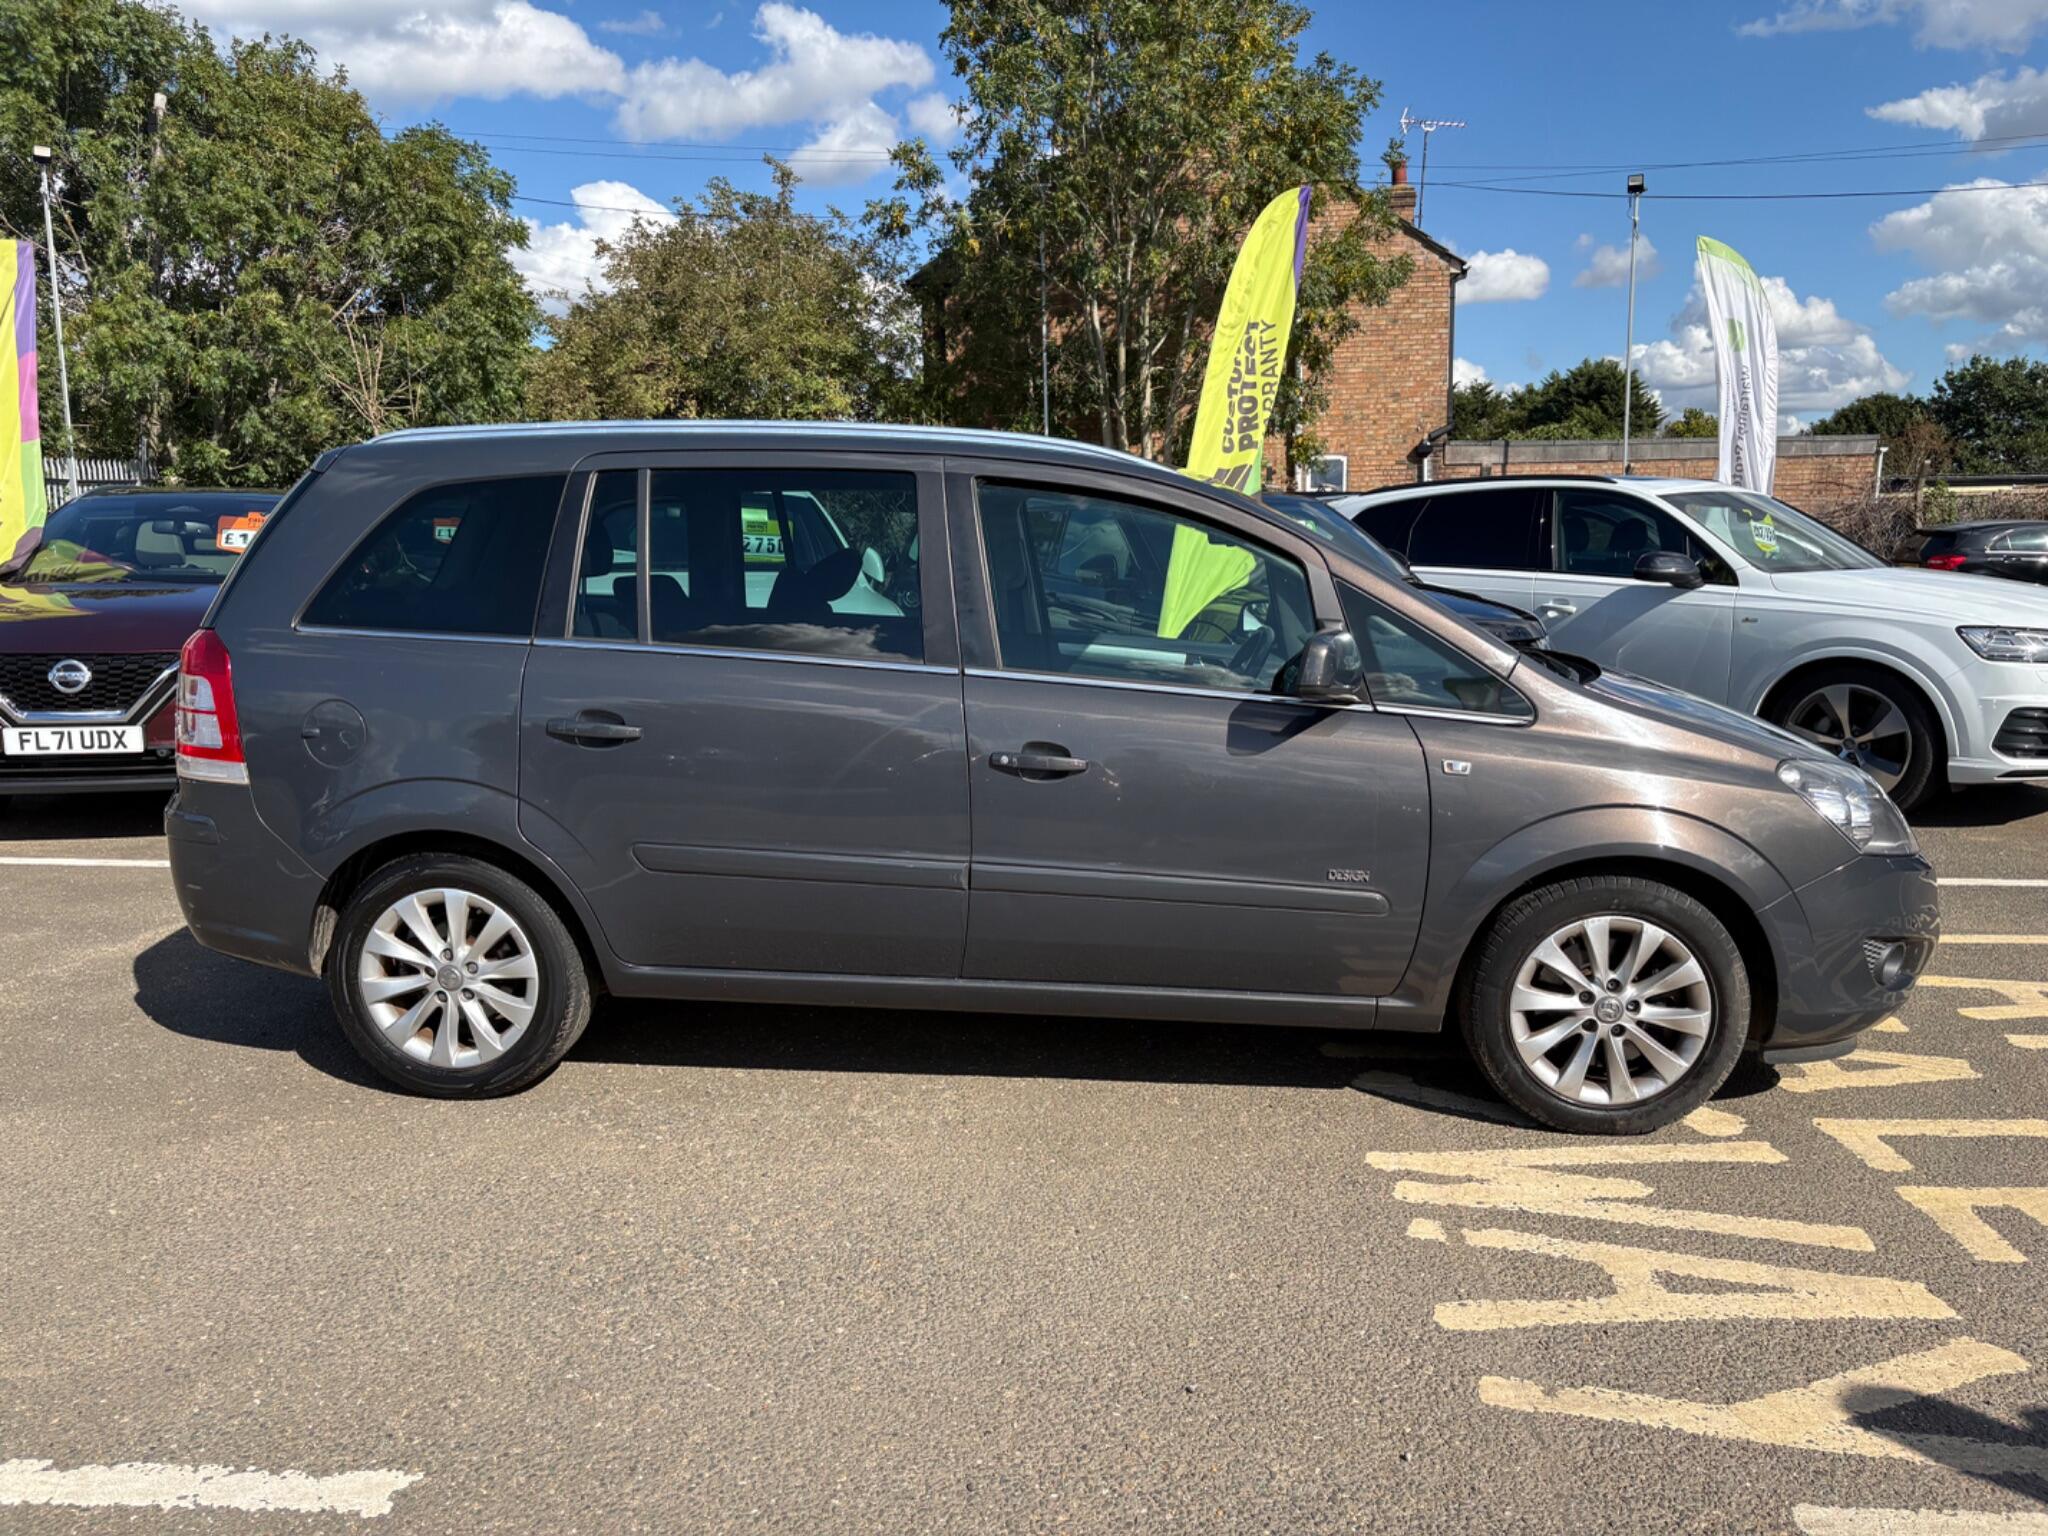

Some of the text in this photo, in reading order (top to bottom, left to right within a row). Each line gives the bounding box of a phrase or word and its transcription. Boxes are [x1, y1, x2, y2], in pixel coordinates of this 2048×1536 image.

[1237, 320, 1259, 452] PROTECT
[1260, 319, 1278, 426] RRANTY
[18, 730, 128, 751] FL71 UDX
[1327, 868, 1371, 882] DESIGN
